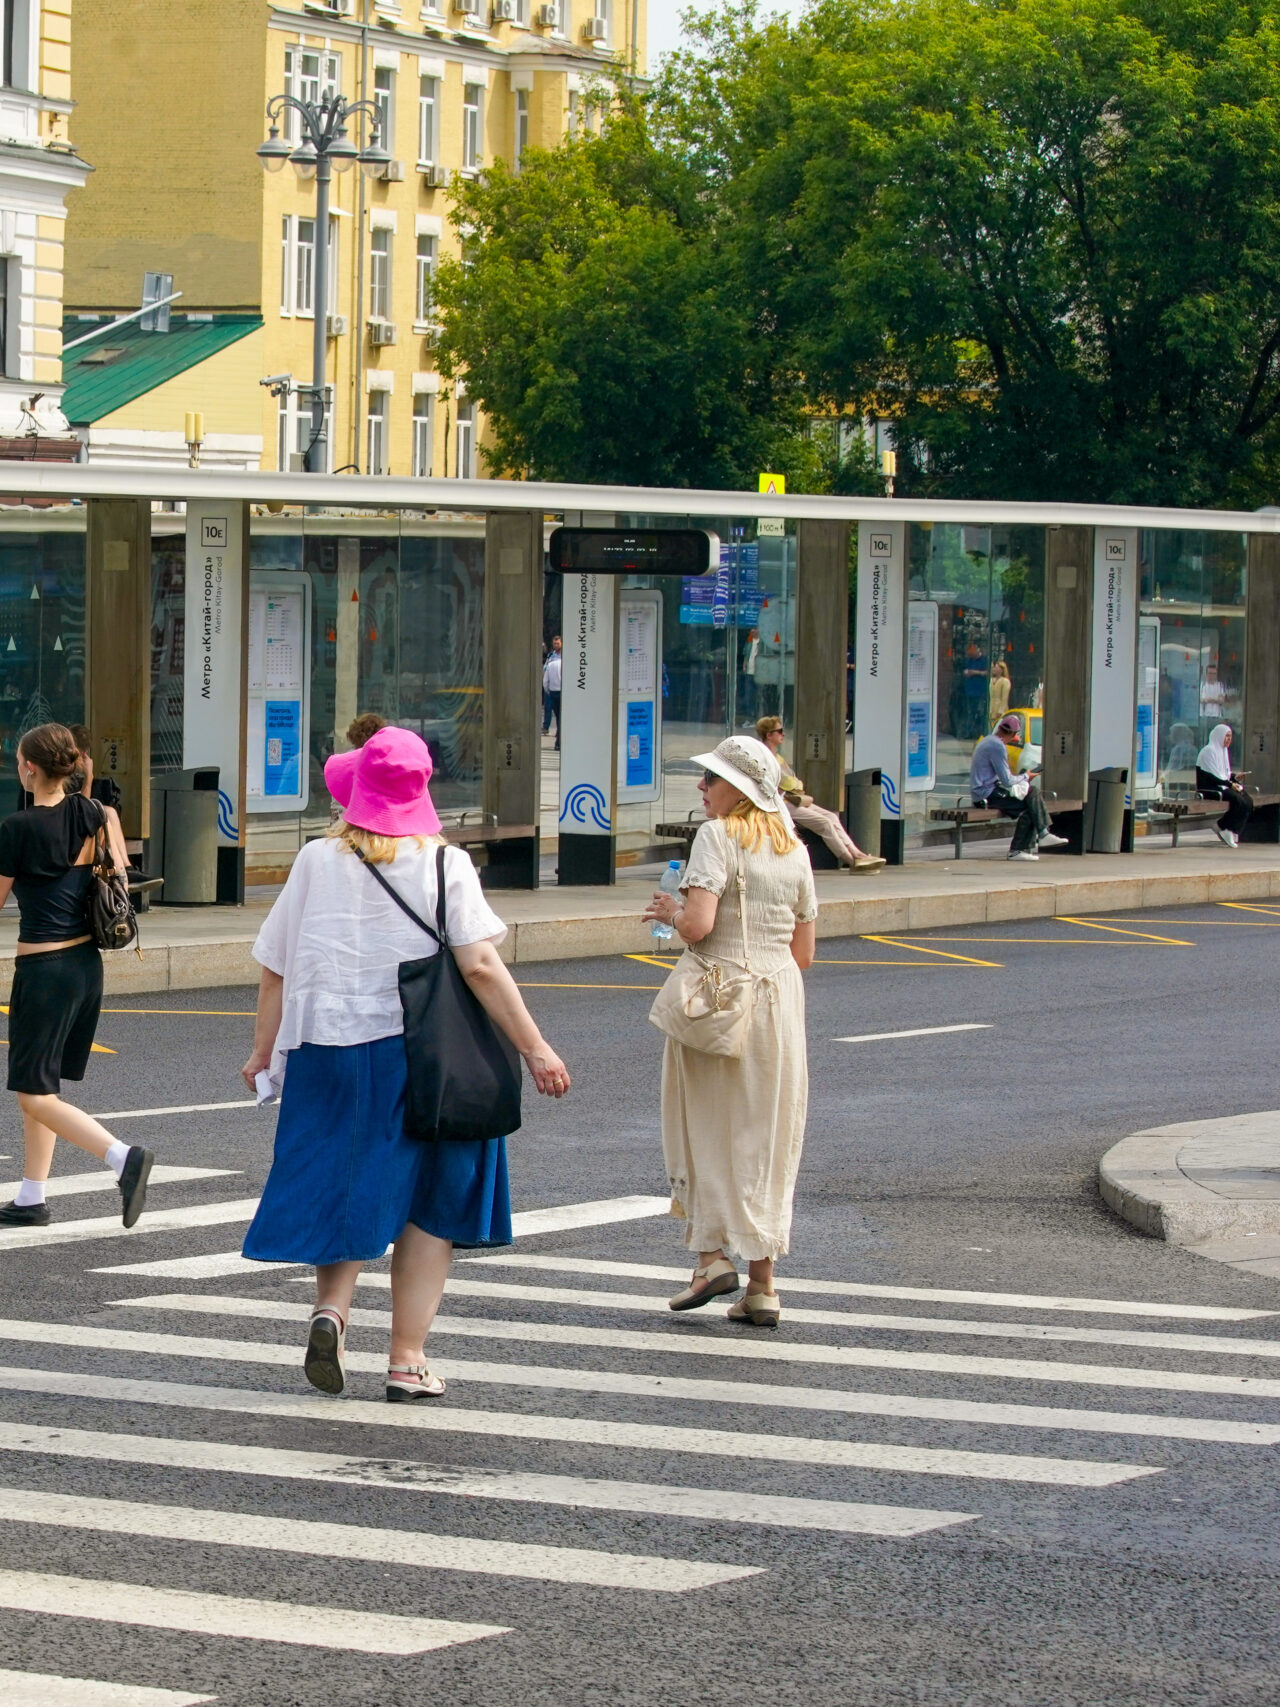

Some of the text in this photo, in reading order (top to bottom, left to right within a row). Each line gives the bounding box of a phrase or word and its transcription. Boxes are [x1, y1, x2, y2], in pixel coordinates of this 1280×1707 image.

[201, 556, 213, 700] Метро «Китай-город»
[214, 556, 223, 634] Metro Kitay-Gorod
[870, 565, 880, 677] Метро «Китай-город»
[577, 650, 588, 690] Метро
[1105, 637, 1113, 668] Метро
